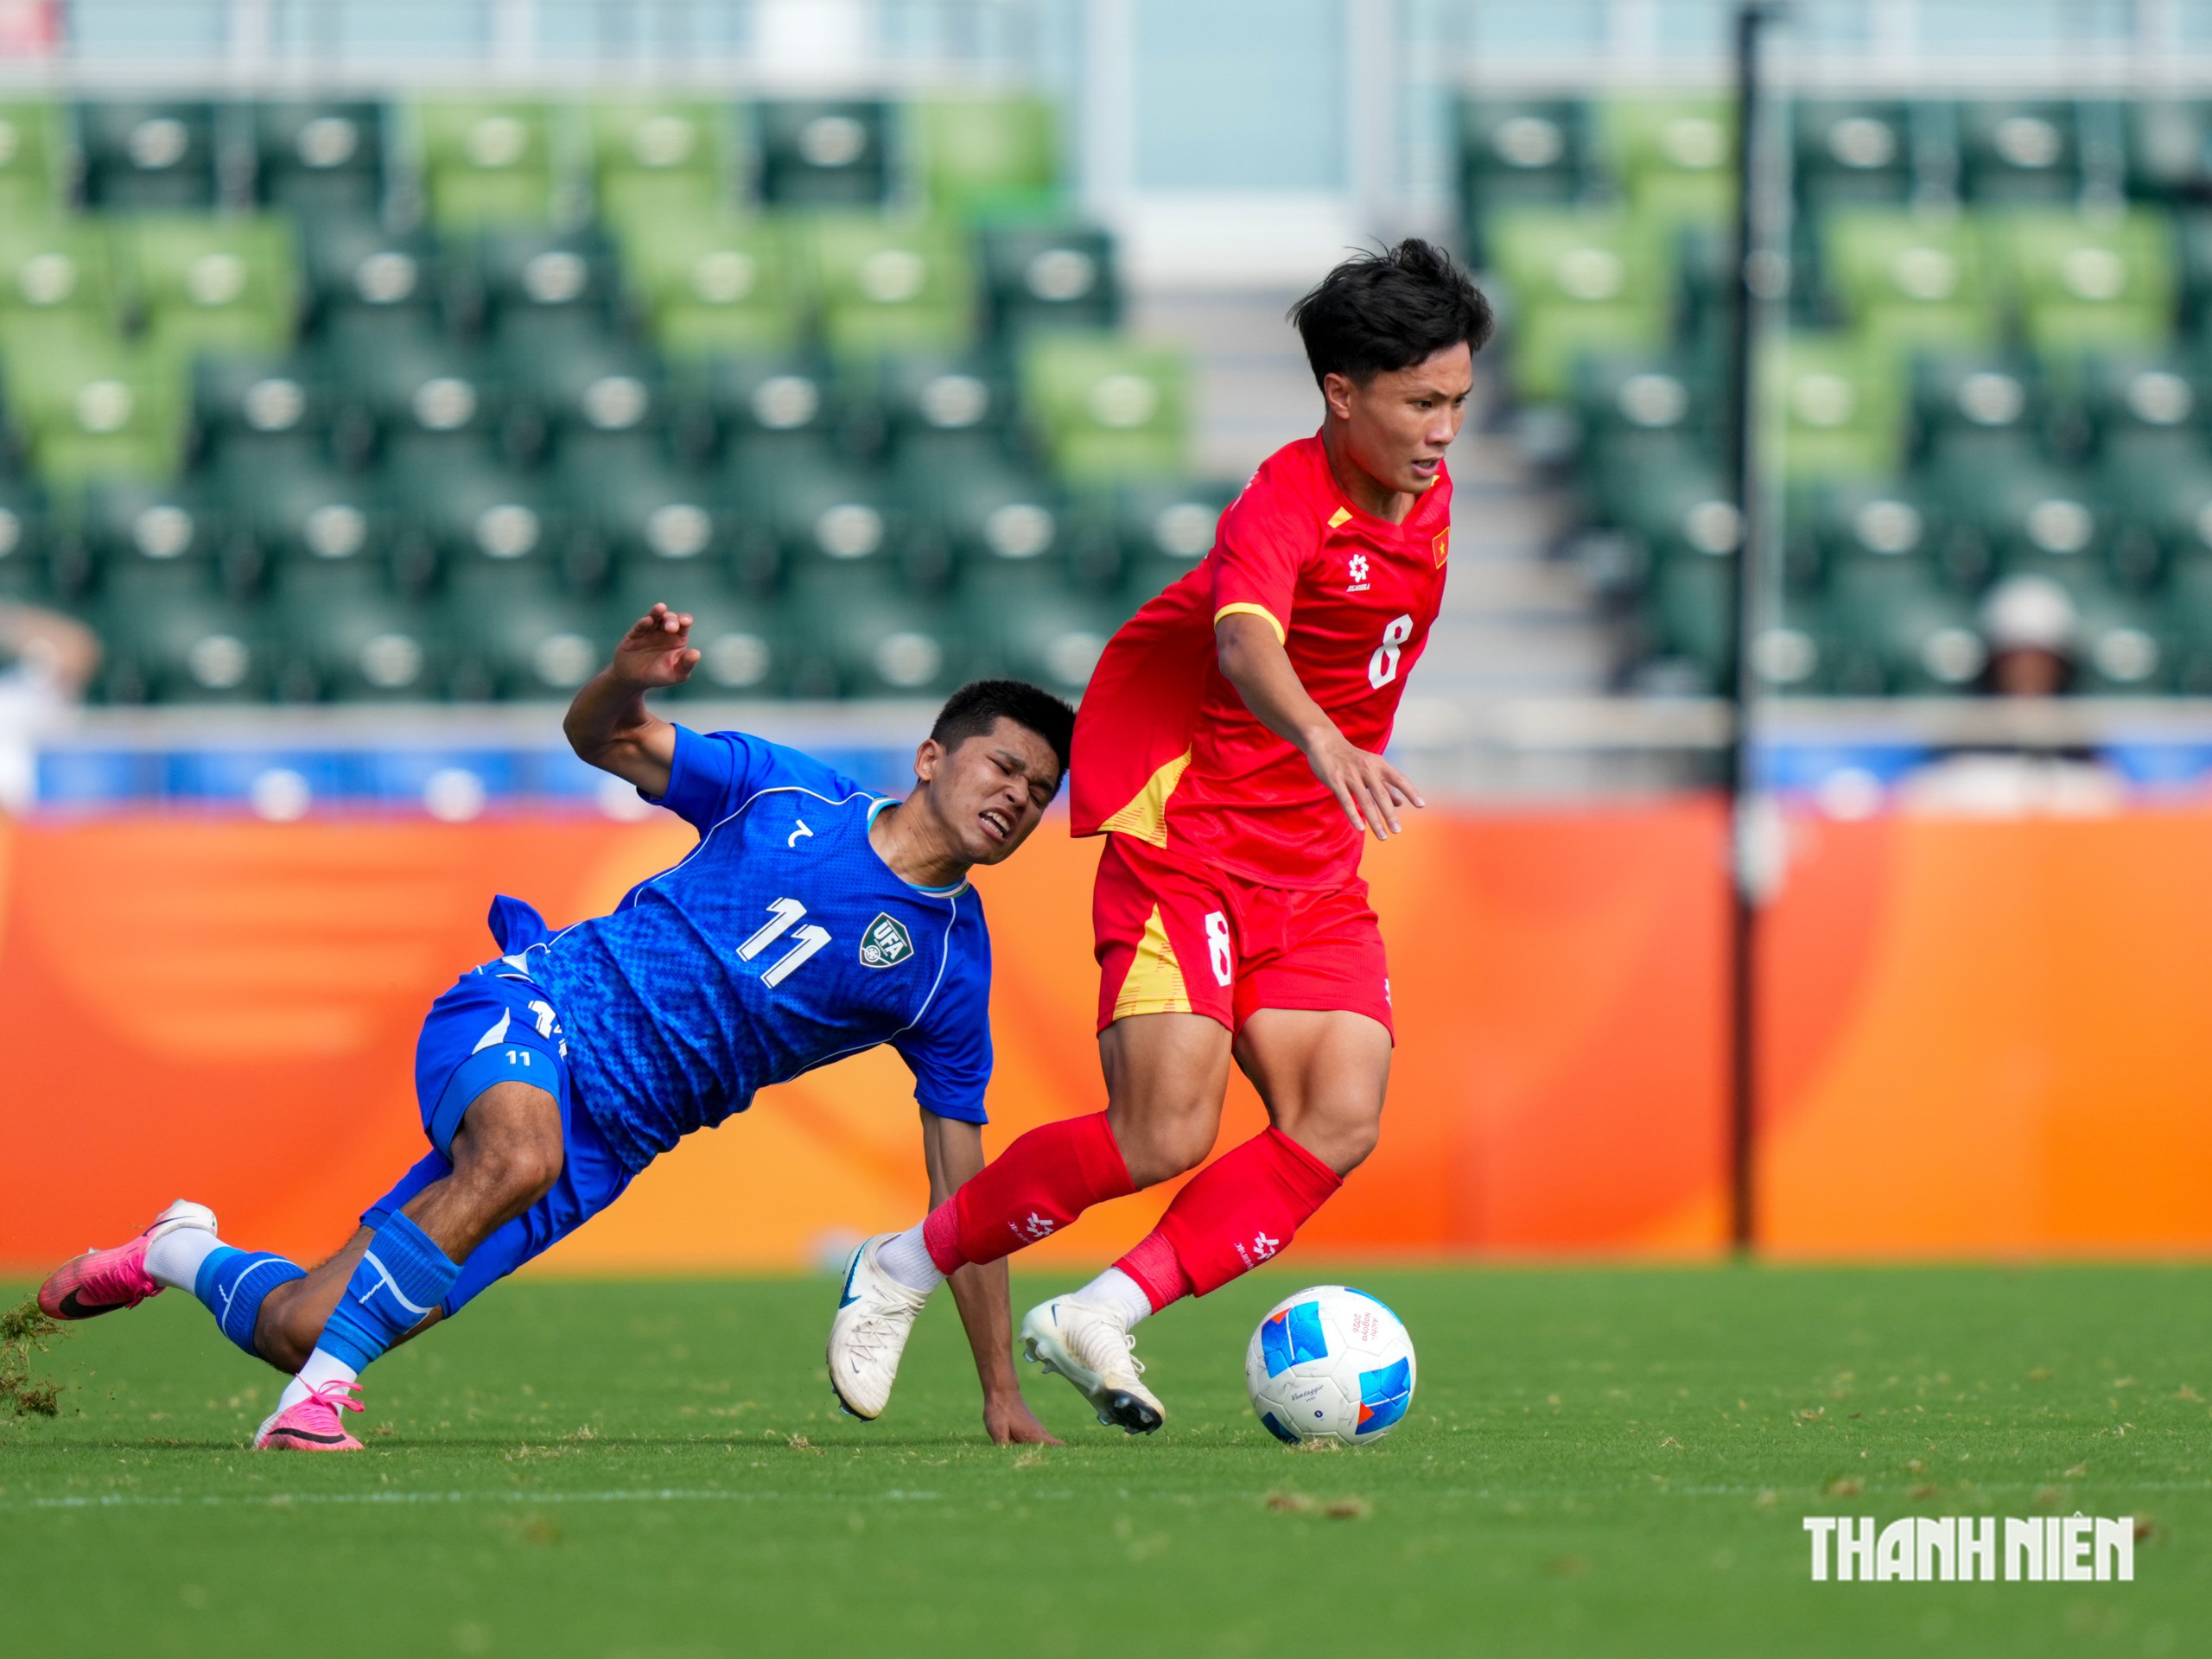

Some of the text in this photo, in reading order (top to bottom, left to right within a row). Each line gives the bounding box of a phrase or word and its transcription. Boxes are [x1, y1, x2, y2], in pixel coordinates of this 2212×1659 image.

[1368, 613, 1414, 690] 8
[735, 897, 832, 989] 11
[874, 921, 904, 960] UFA
[1205, 911, 1231, 987] 8
[505, 1050, 531, 1067] 11
[1352, 1313, 1362, 1333] 2026
[1361, 1312, 1371, 1342] Nagoya
